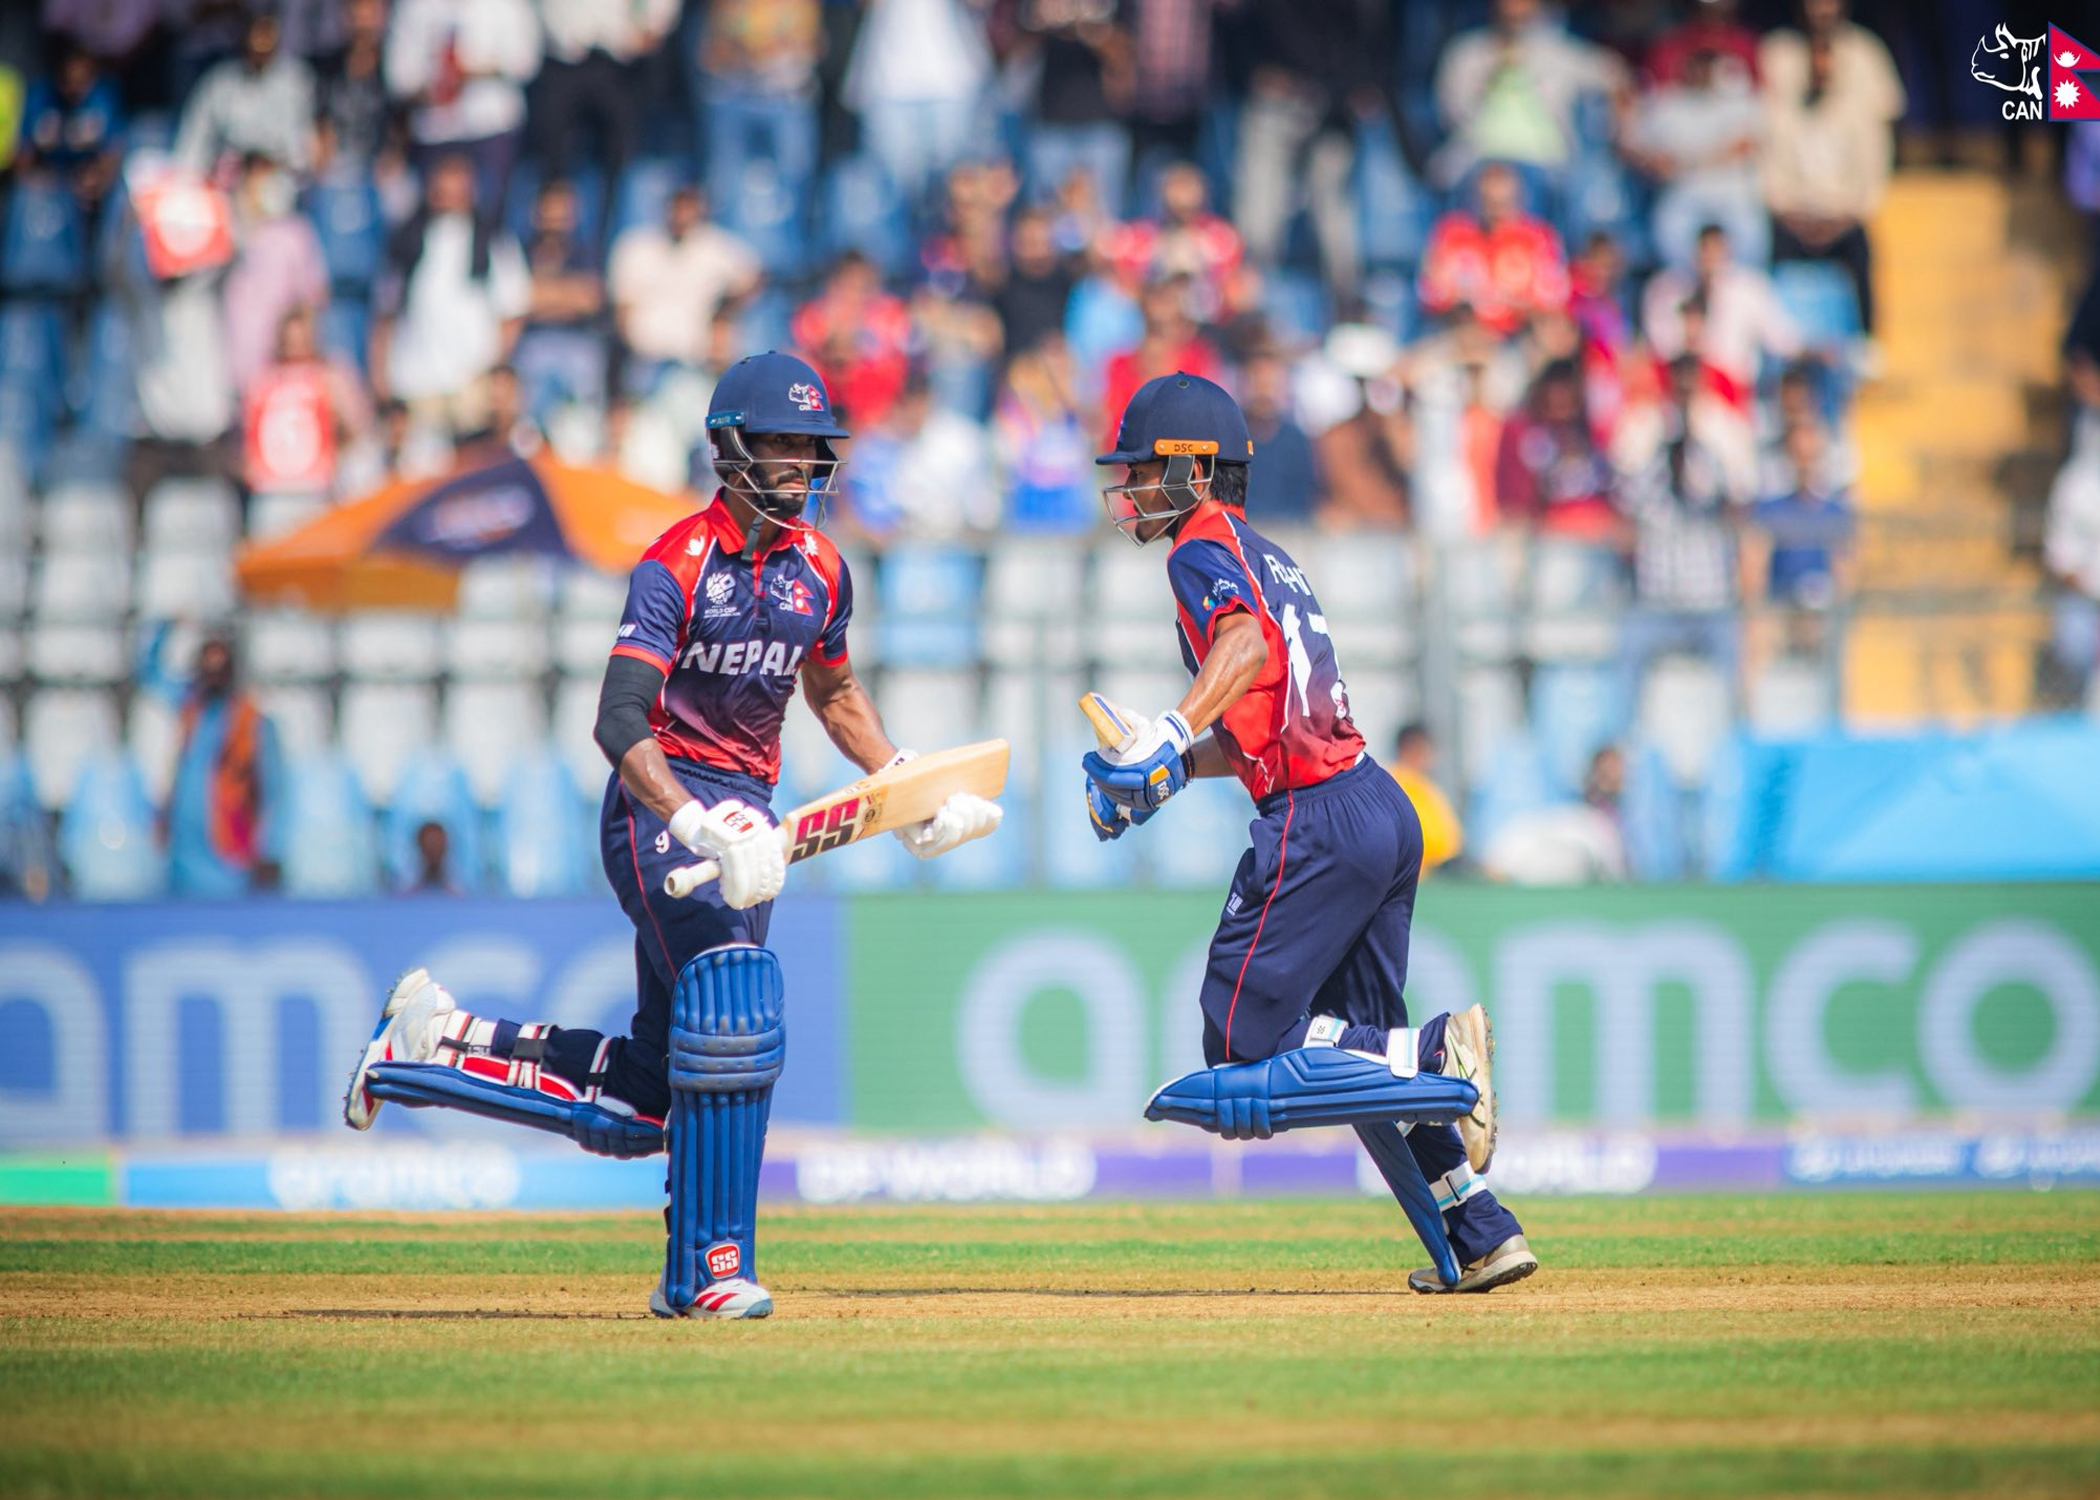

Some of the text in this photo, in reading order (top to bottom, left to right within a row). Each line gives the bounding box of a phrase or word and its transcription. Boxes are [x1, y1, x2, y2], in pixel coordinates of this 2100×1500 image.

[1173, 443, 1194, 453] DSC
[681, 640, 803, 676] NEPAL
[654, 829, 671, 854] 9
[790, 797, 861, 865] SS
[711, 1250, 738, 1273] SS
